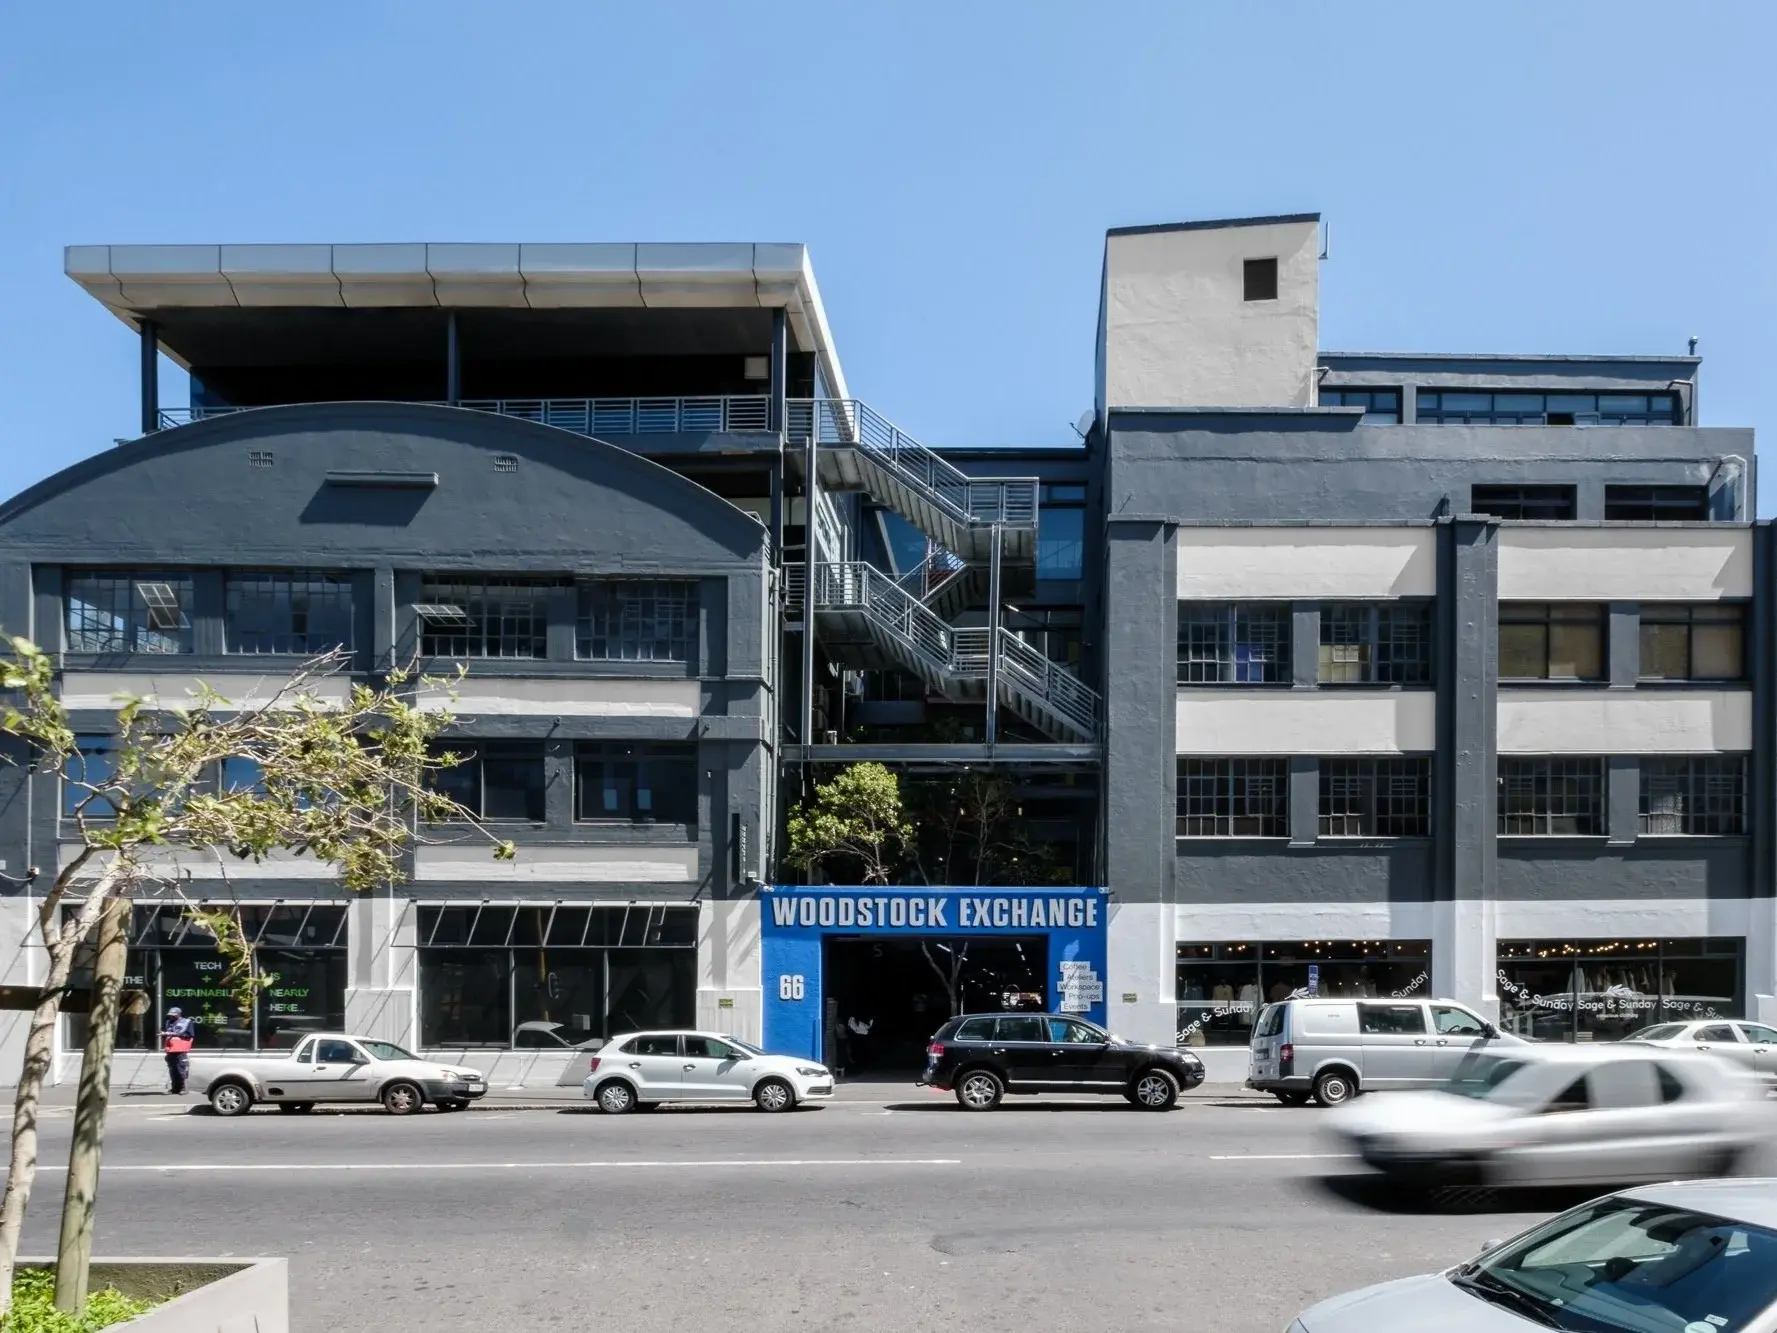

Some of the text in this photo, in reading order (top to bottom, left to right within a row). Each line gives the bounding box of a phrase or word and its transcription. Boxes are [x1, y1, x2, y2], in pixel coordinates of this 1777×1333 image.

[772, 897, 1098, 927] WOODSTOCK EXCHANGE
[194, 961, 222, 970] TECH
[122, 976, 144, 984] THE
[1391, 970, 1429, 999] Sunday
[166, 988, 243, 997] SUSTAINABILI
[270, 988, 309, 997] NEARLY
[779, 974, 804, 1000] 66
[1060, 983, 1100, 991] Workspace
[1496, 969, 1574, 1012] Sage & Sunday
[1069, 993, 1100, 1001] Pop-ups
[1578, 999, 1656, 1011] Sage & Sunday
[1662, 999, 1725, 1021] Sage & Sun
[1176, 1001, 1256, 1042] Sage & Sunday
